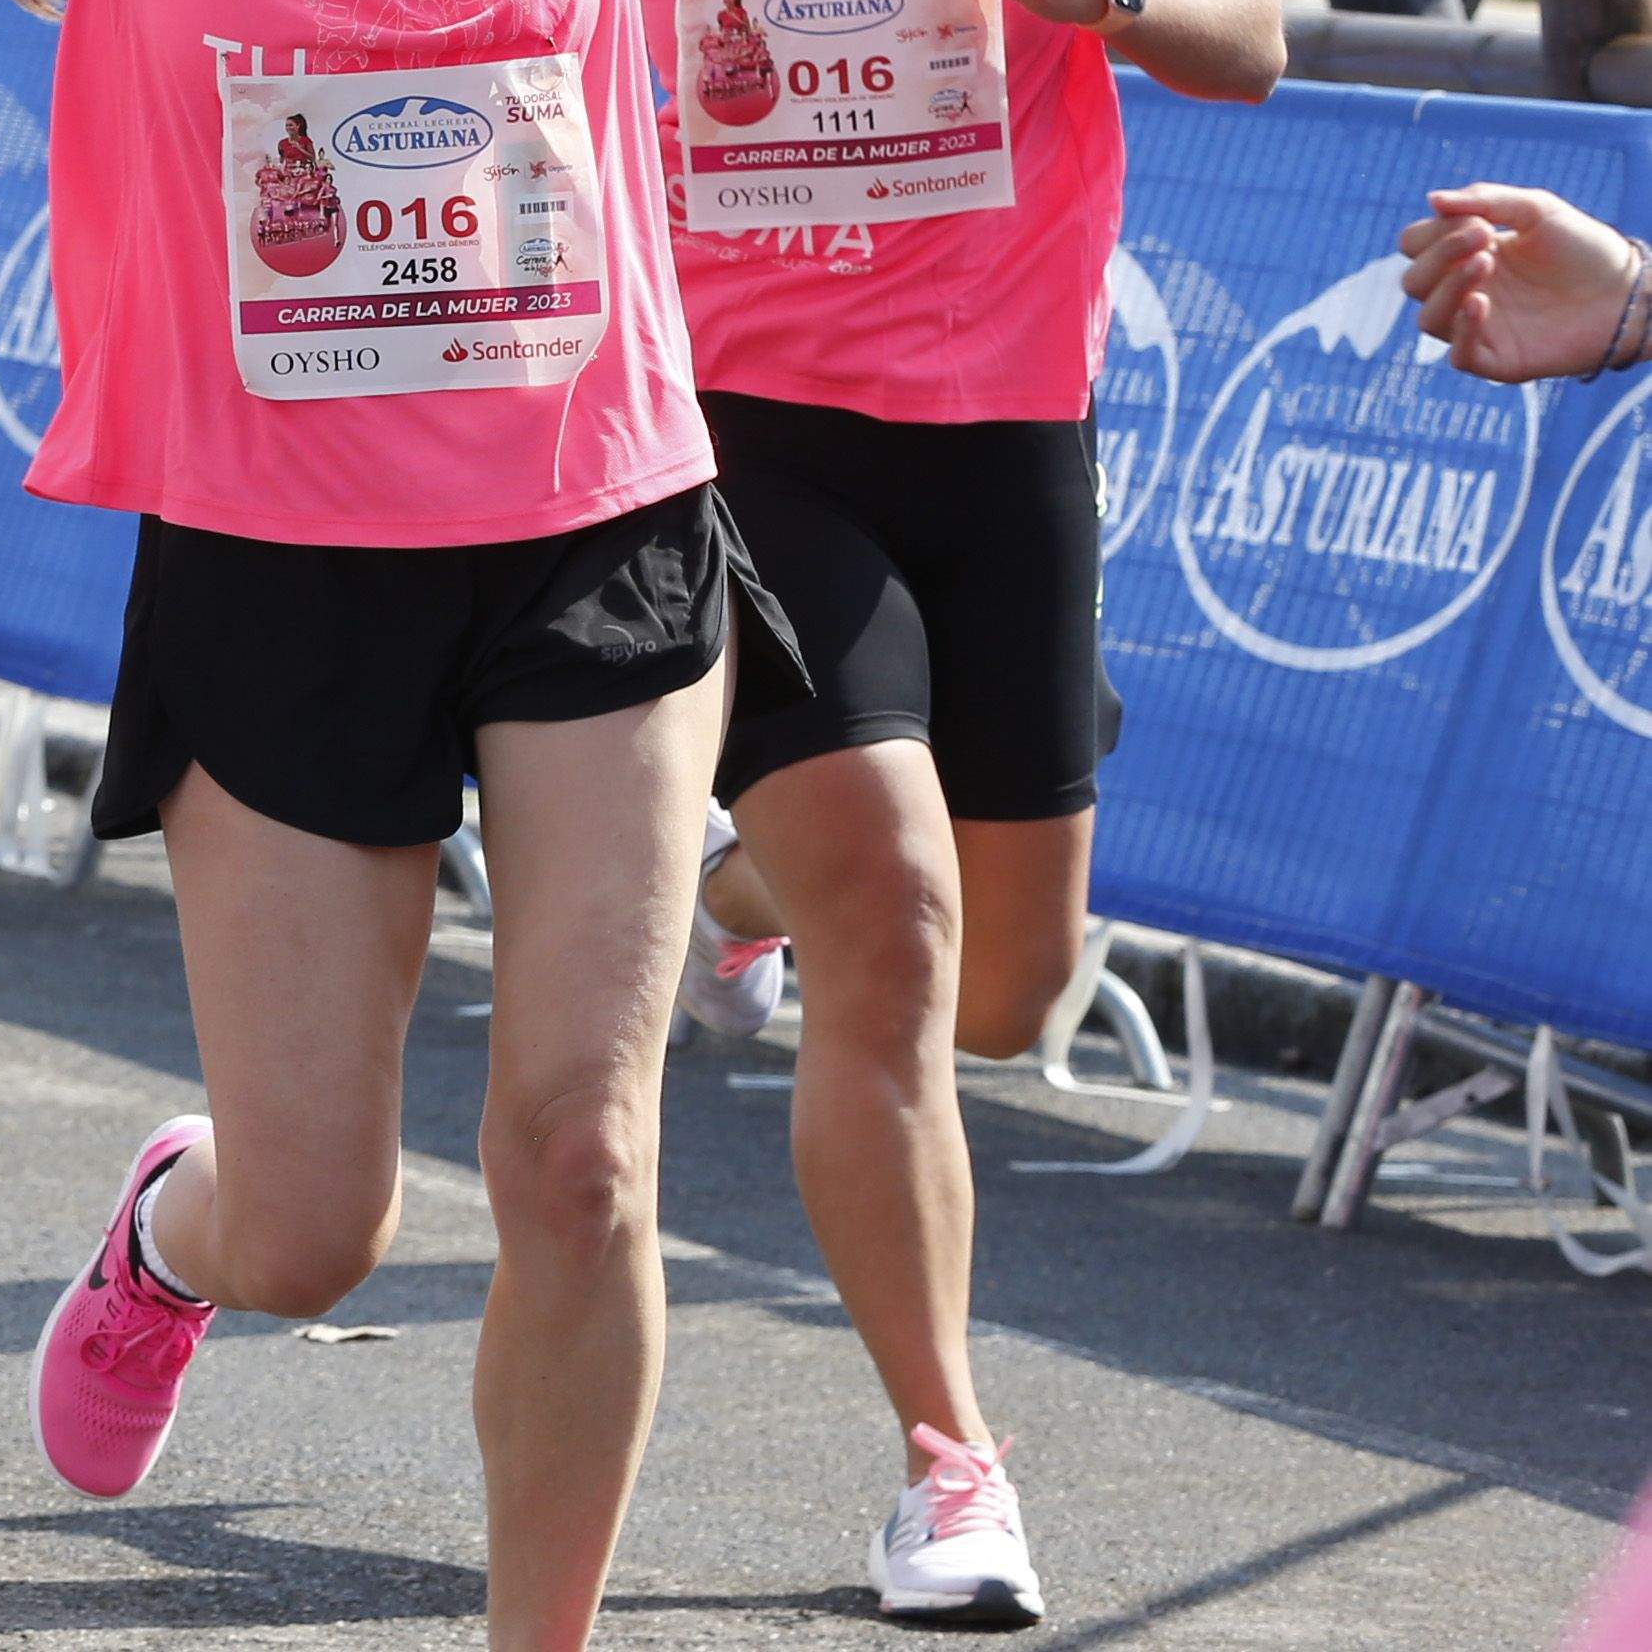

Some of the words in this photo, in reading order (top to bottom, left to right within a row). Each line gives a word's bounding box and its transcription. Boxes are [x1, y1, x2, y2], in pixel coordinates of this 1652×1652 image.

[786, 55, 895, 97] 016
[505, 96, 521, 106] TU
[523, 91, 563, 104] DORSAL
[368, 120, 419, 131] CENTRAL
[424, 116, 476, 128] LECHERA
[506, 102, 565, 124] SUMA
[812, 108, 877, 133] 1111
[345, 125, 482, 154] ASTURIANA
[723, 148, 809, 166] CARRERA
[812, 146, 837, 162] DE
[841, 145, 865, 160] LA
[869, 139, 932, 159] MUJER
[938, 132, 977, 152] 2023
[718, 184, 813, 209] OYSHO
[892, 171, 987, 199] Santander
[356, 195, 480, 243] 016
[397, 241, 436, 251] VIOLENCIA
[437, 240, 447, 248] DE
[381, 257, 458, 286] 2458
[278, 304, 376, 325] CARRERA
[381, 302, 410, 319] DE
[415, 299, 443, 317] LA
[447, 296, 518, 316] MUJER
[526, 292, 573, 313] 2023
[270, 347, 382, 376] OYSHO
[472, 336, 584, 361] Santander
[1197, 389, 1497, 574] ASTURIANA
[600, 639, 657, 666] spyro
